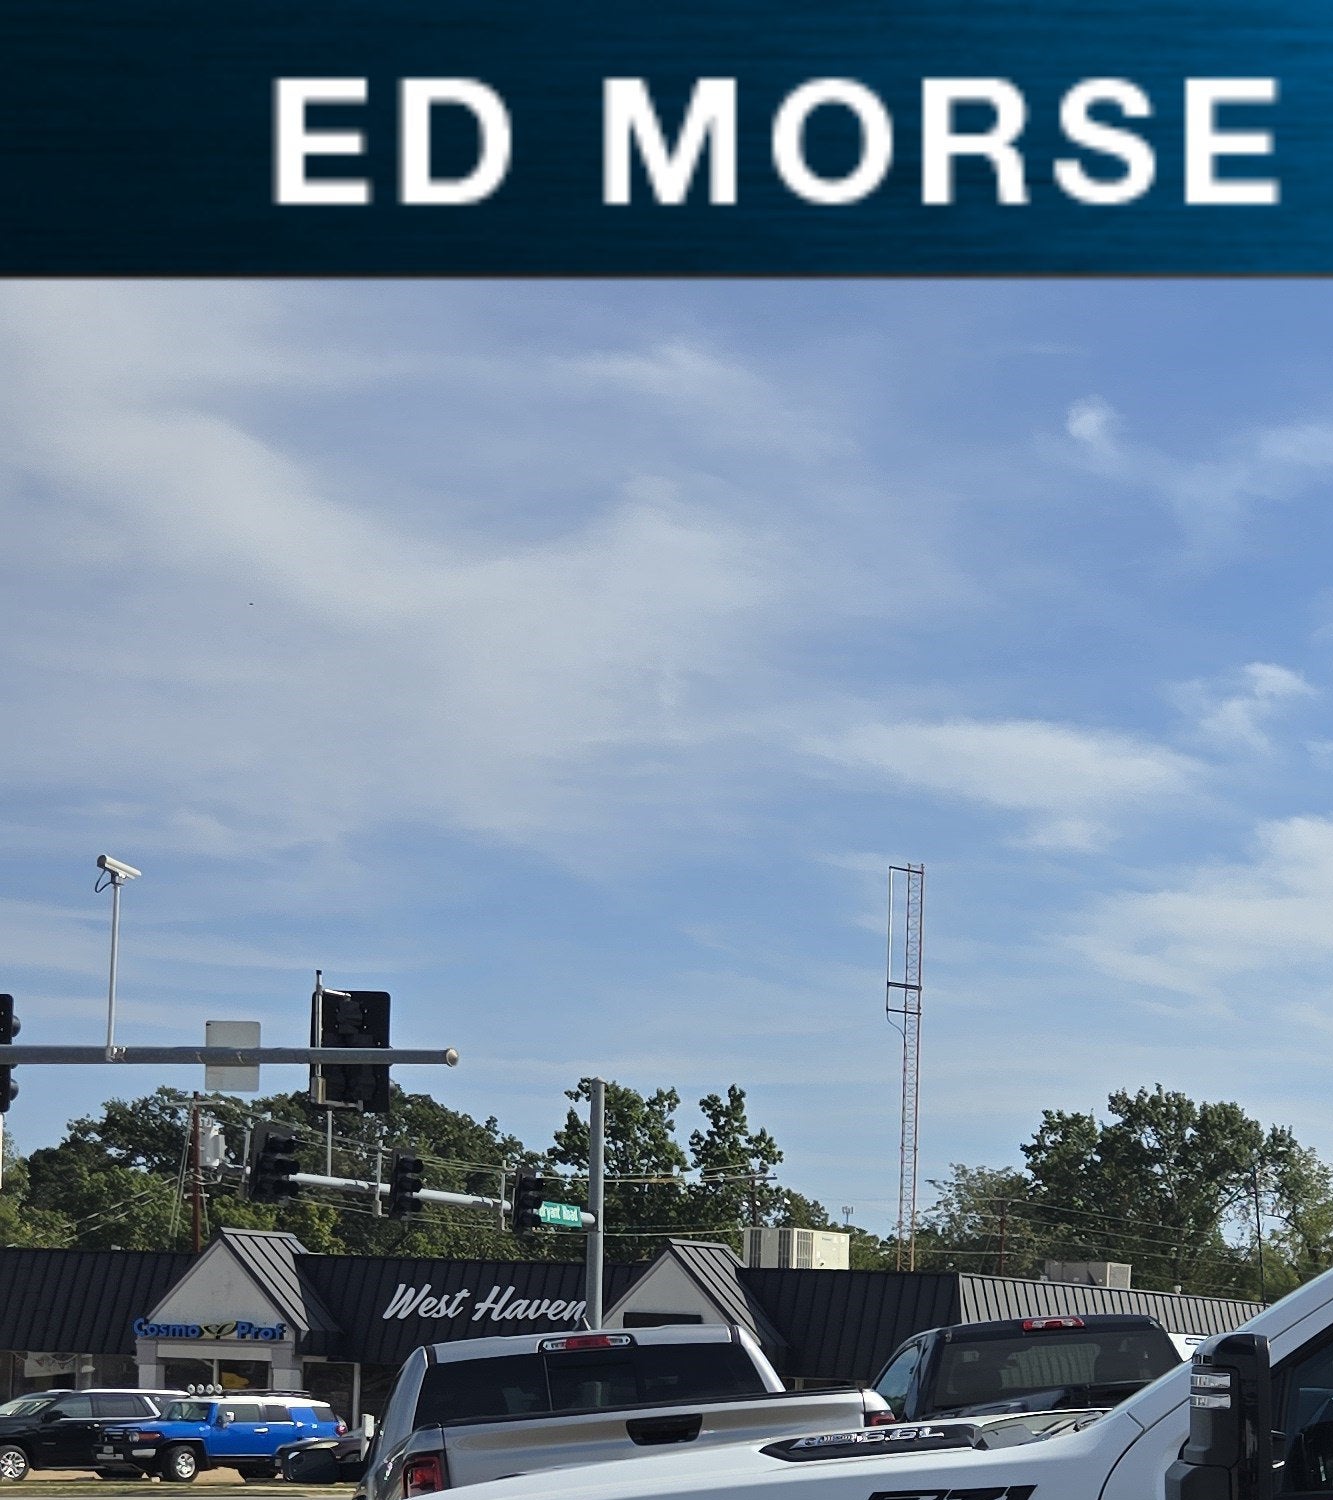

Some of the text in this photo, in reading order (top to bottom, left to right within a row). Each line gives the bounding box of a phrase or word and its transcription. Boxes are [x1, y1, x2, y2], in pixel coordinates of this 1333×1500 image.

[382, 1284, 587, 1321] West Haven
[132, 1317, 286, 1340] Cosmo Prof
